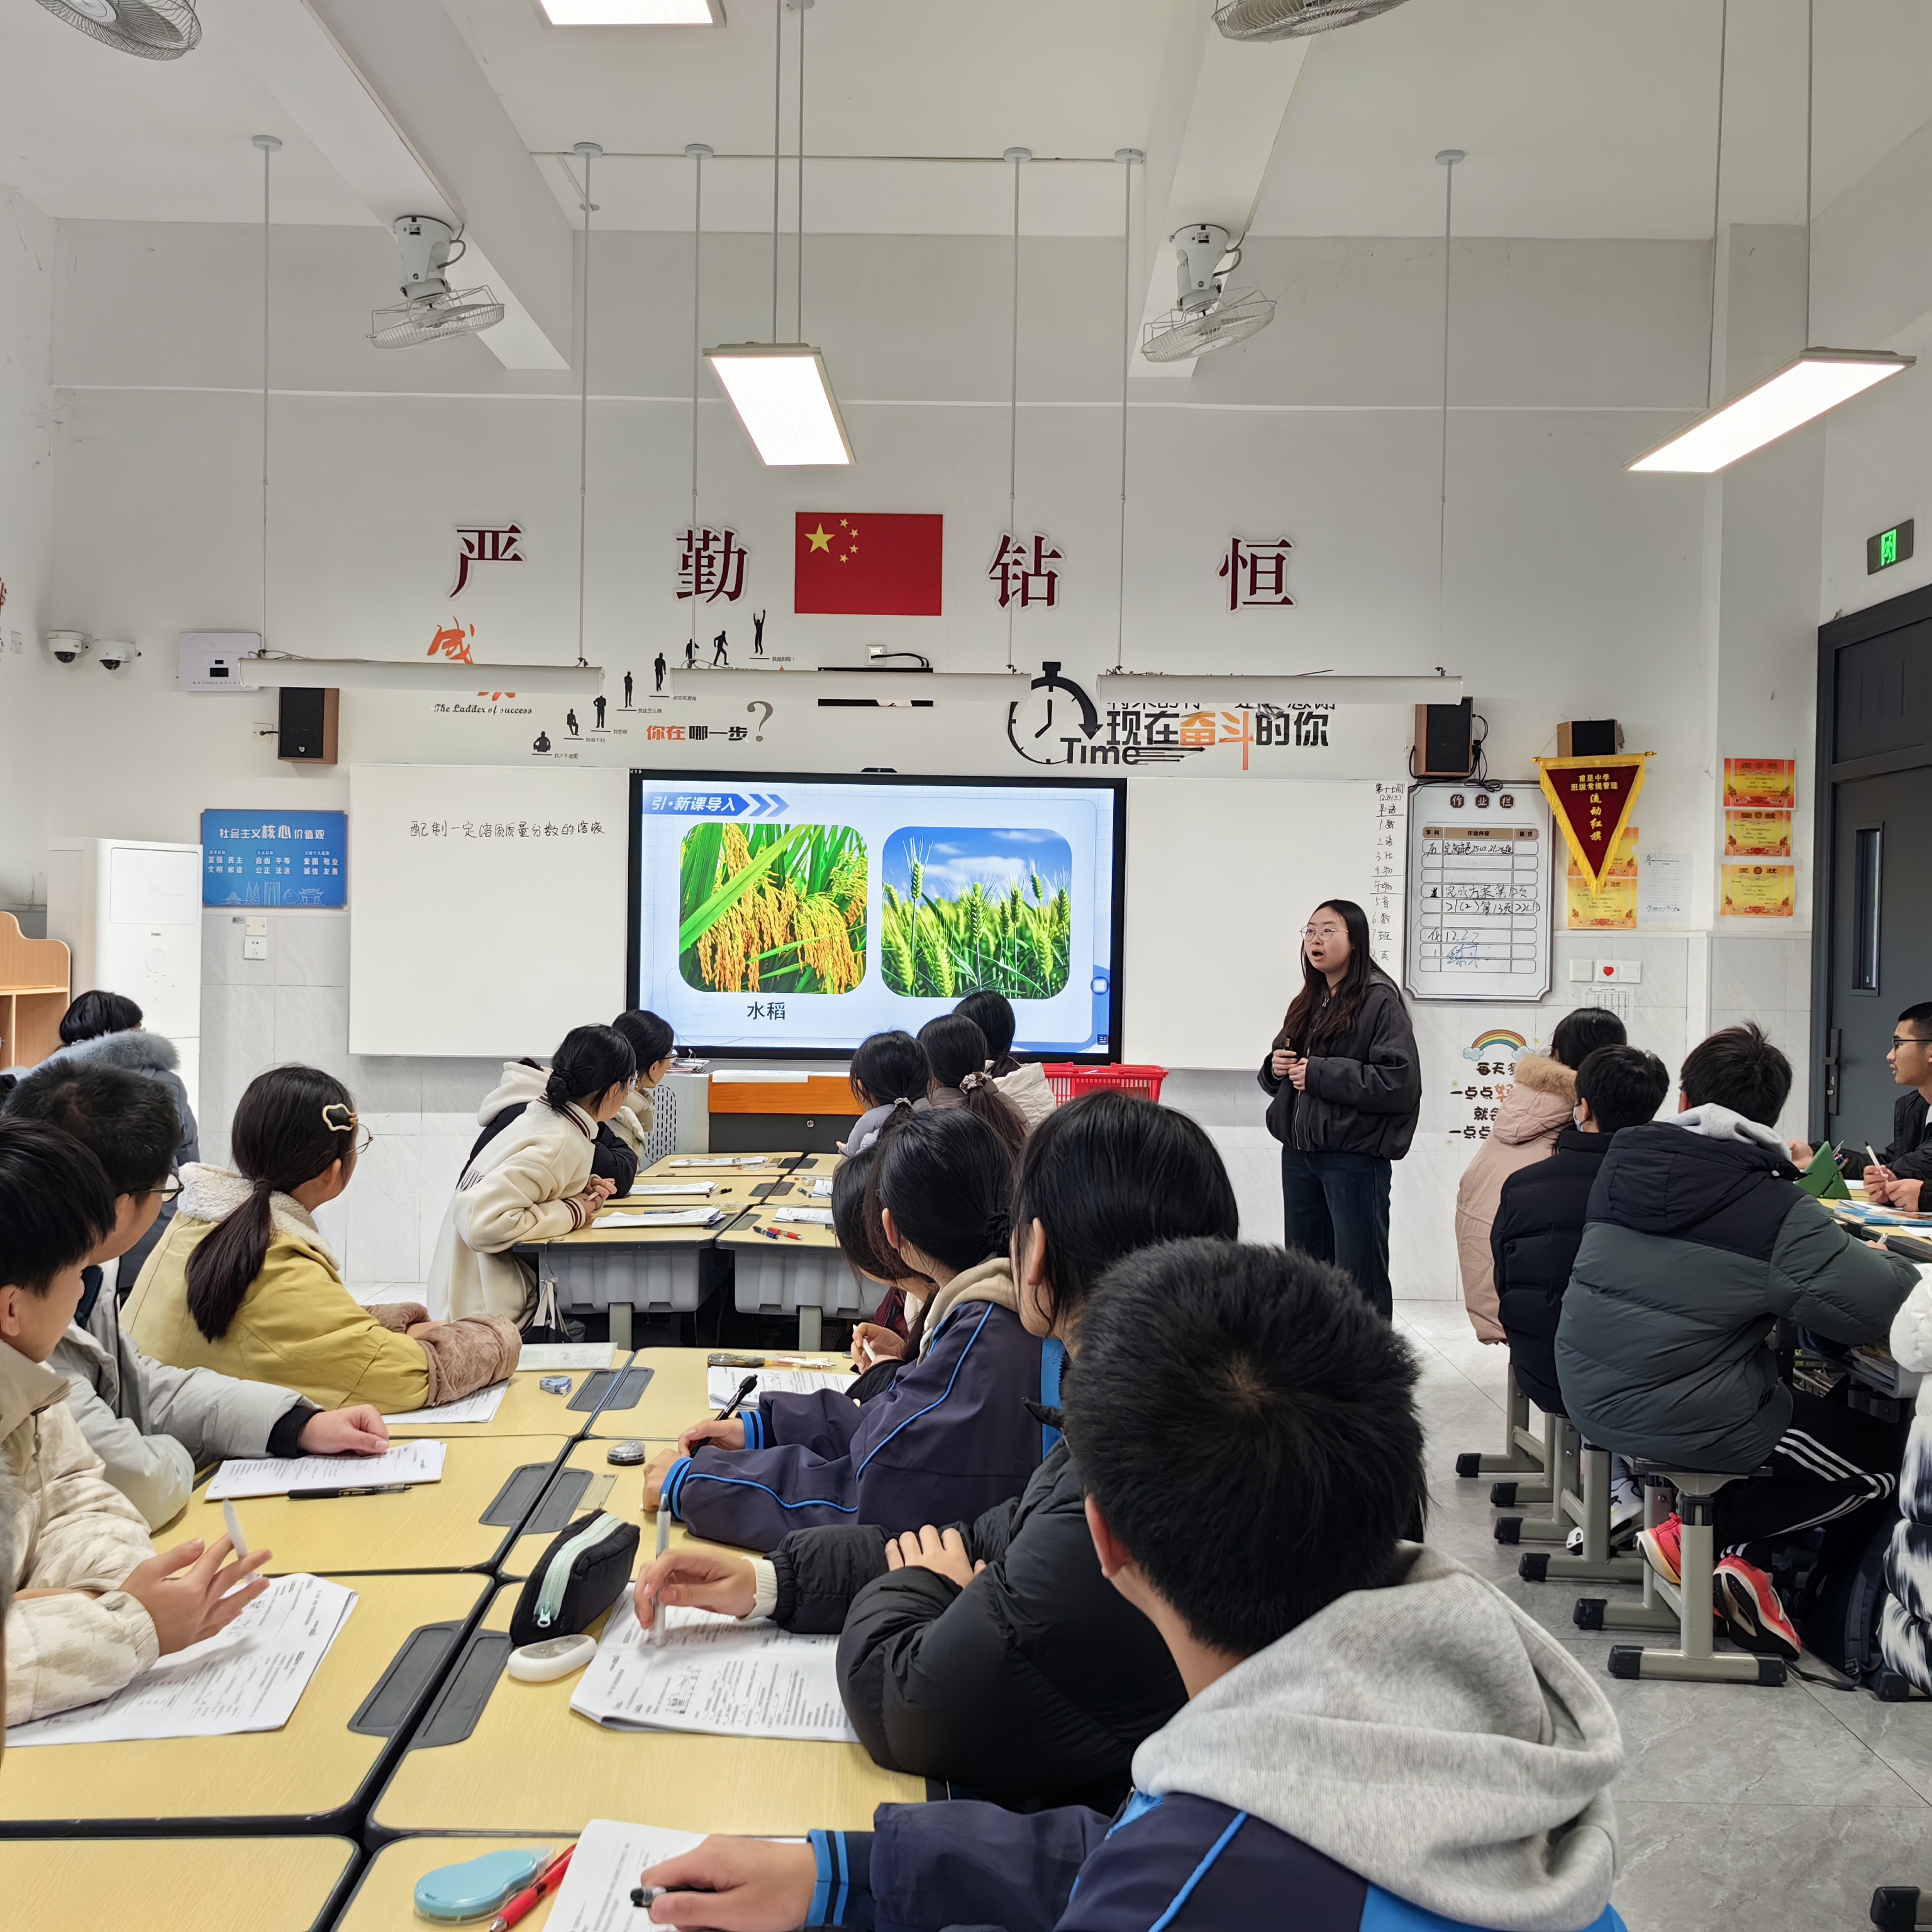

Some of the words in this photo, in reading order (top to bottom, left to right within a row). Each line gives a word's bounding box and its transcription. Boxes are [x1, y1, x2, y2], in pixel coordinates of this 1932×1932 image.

[449, 524, 523, 599] 严
[675, 529, 748, 604] 勤
[989, 534, 1063, 608] 钻
[1218, 536, 1294, 611] 恒
[433, 704, 450, 713] The
[452, 704, 486, 714] Ladder
[487, 705, 498, 716] of
[1106, 710, 1329, 770] 现在奋斗的你
[1060, 736, 1140, 765] Time
[651, 796, 736, 813] 引·新课导入
[1452, 795, 1513, 808] 作业栏
[1589, 792, 1603, 841] 流动红旗
[219, 824, 326, 840] 社会主义核心价值观
[410, 819, 606, 838] 配制一定溶质质量分数的溶液
[228, 856, 243, 864] 民主
[255, 857, 270, 865] 自由
[275, 857, 291, 865] 平等
[303, 857, 319, 865] 爱国
[275, 867, 291, 875] 法治
[323, 867, 338, 875] 友善
[747, 1001, 786, 1020] 水稻
[1448, 1125, 1491, 1139] 一点点
